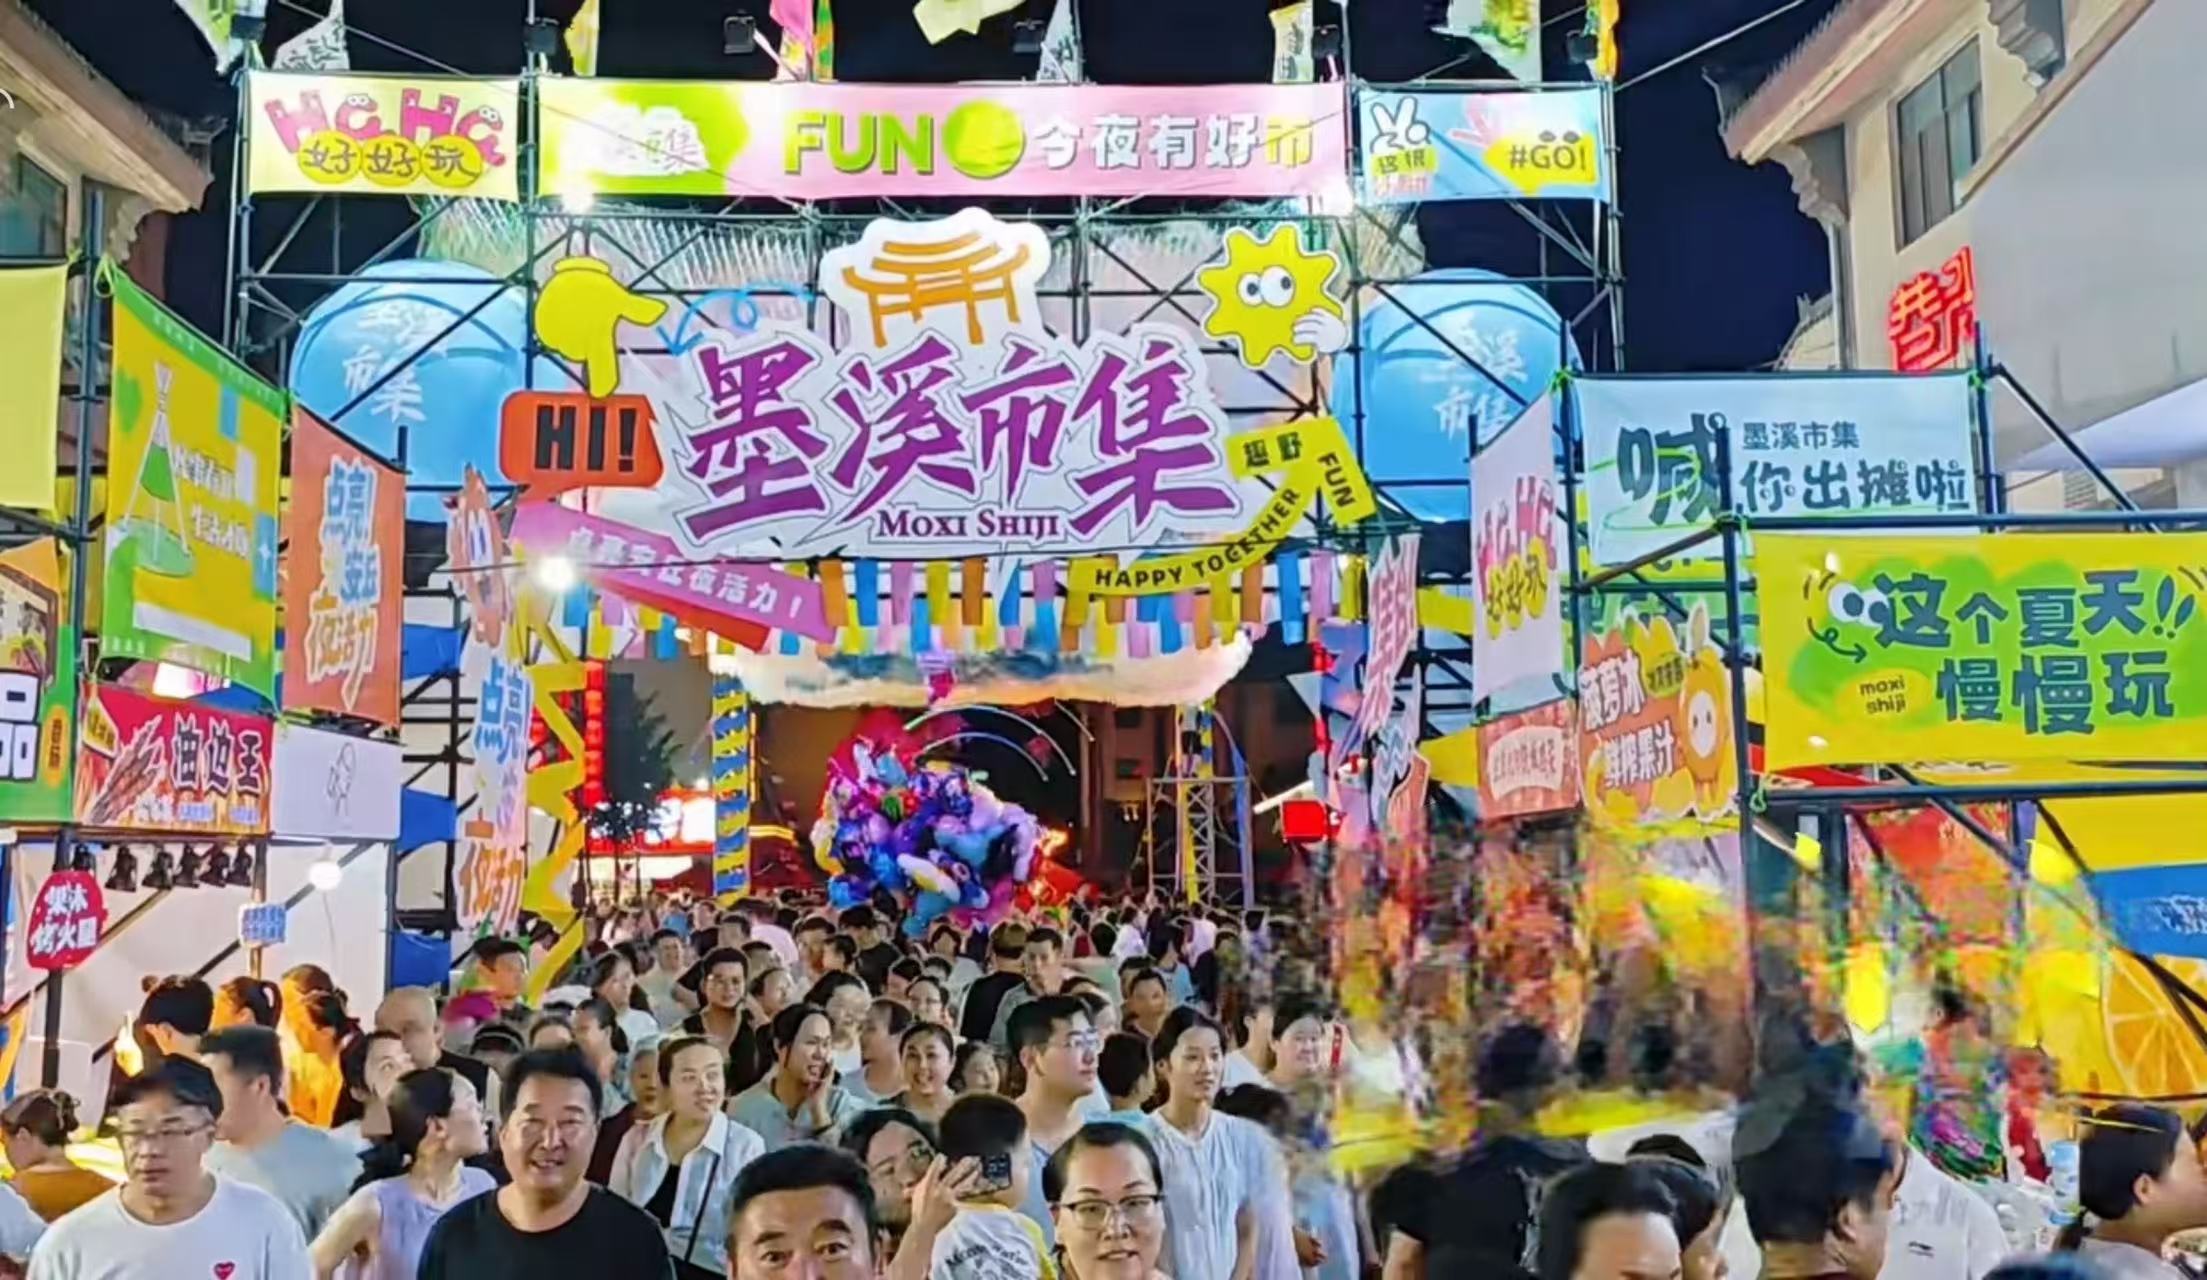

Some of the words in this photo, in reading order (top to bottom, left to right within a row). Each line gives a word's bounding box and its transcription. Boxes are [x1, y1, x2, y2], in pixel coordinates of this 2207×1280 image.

[303, 139, 480, 178] 好好玩
[783, 111, 935, 175] FUN
[1030, 113, 1314, 170] 今夜有好市
[1509, 144, 1587, 171] #GO!
[534, 405, 638, 473] HI!
[686, 334, 1237, 537] 墨溪市集
[1742, 421, 1861, 451] 墨溪市集
[1317, 451, 1357, 509] FUN
[1740, 458, 1970, 514] 你出摊啦
[1094, 566, 1182, 589] HAPPY
[1191, 487, 1301, 579] TOGETHER
[1858, 673, 1906, 697] moxi
[1865, 693, 1907, 717] shiji
[1935, 650, 2176, 736] 慢慢玩
